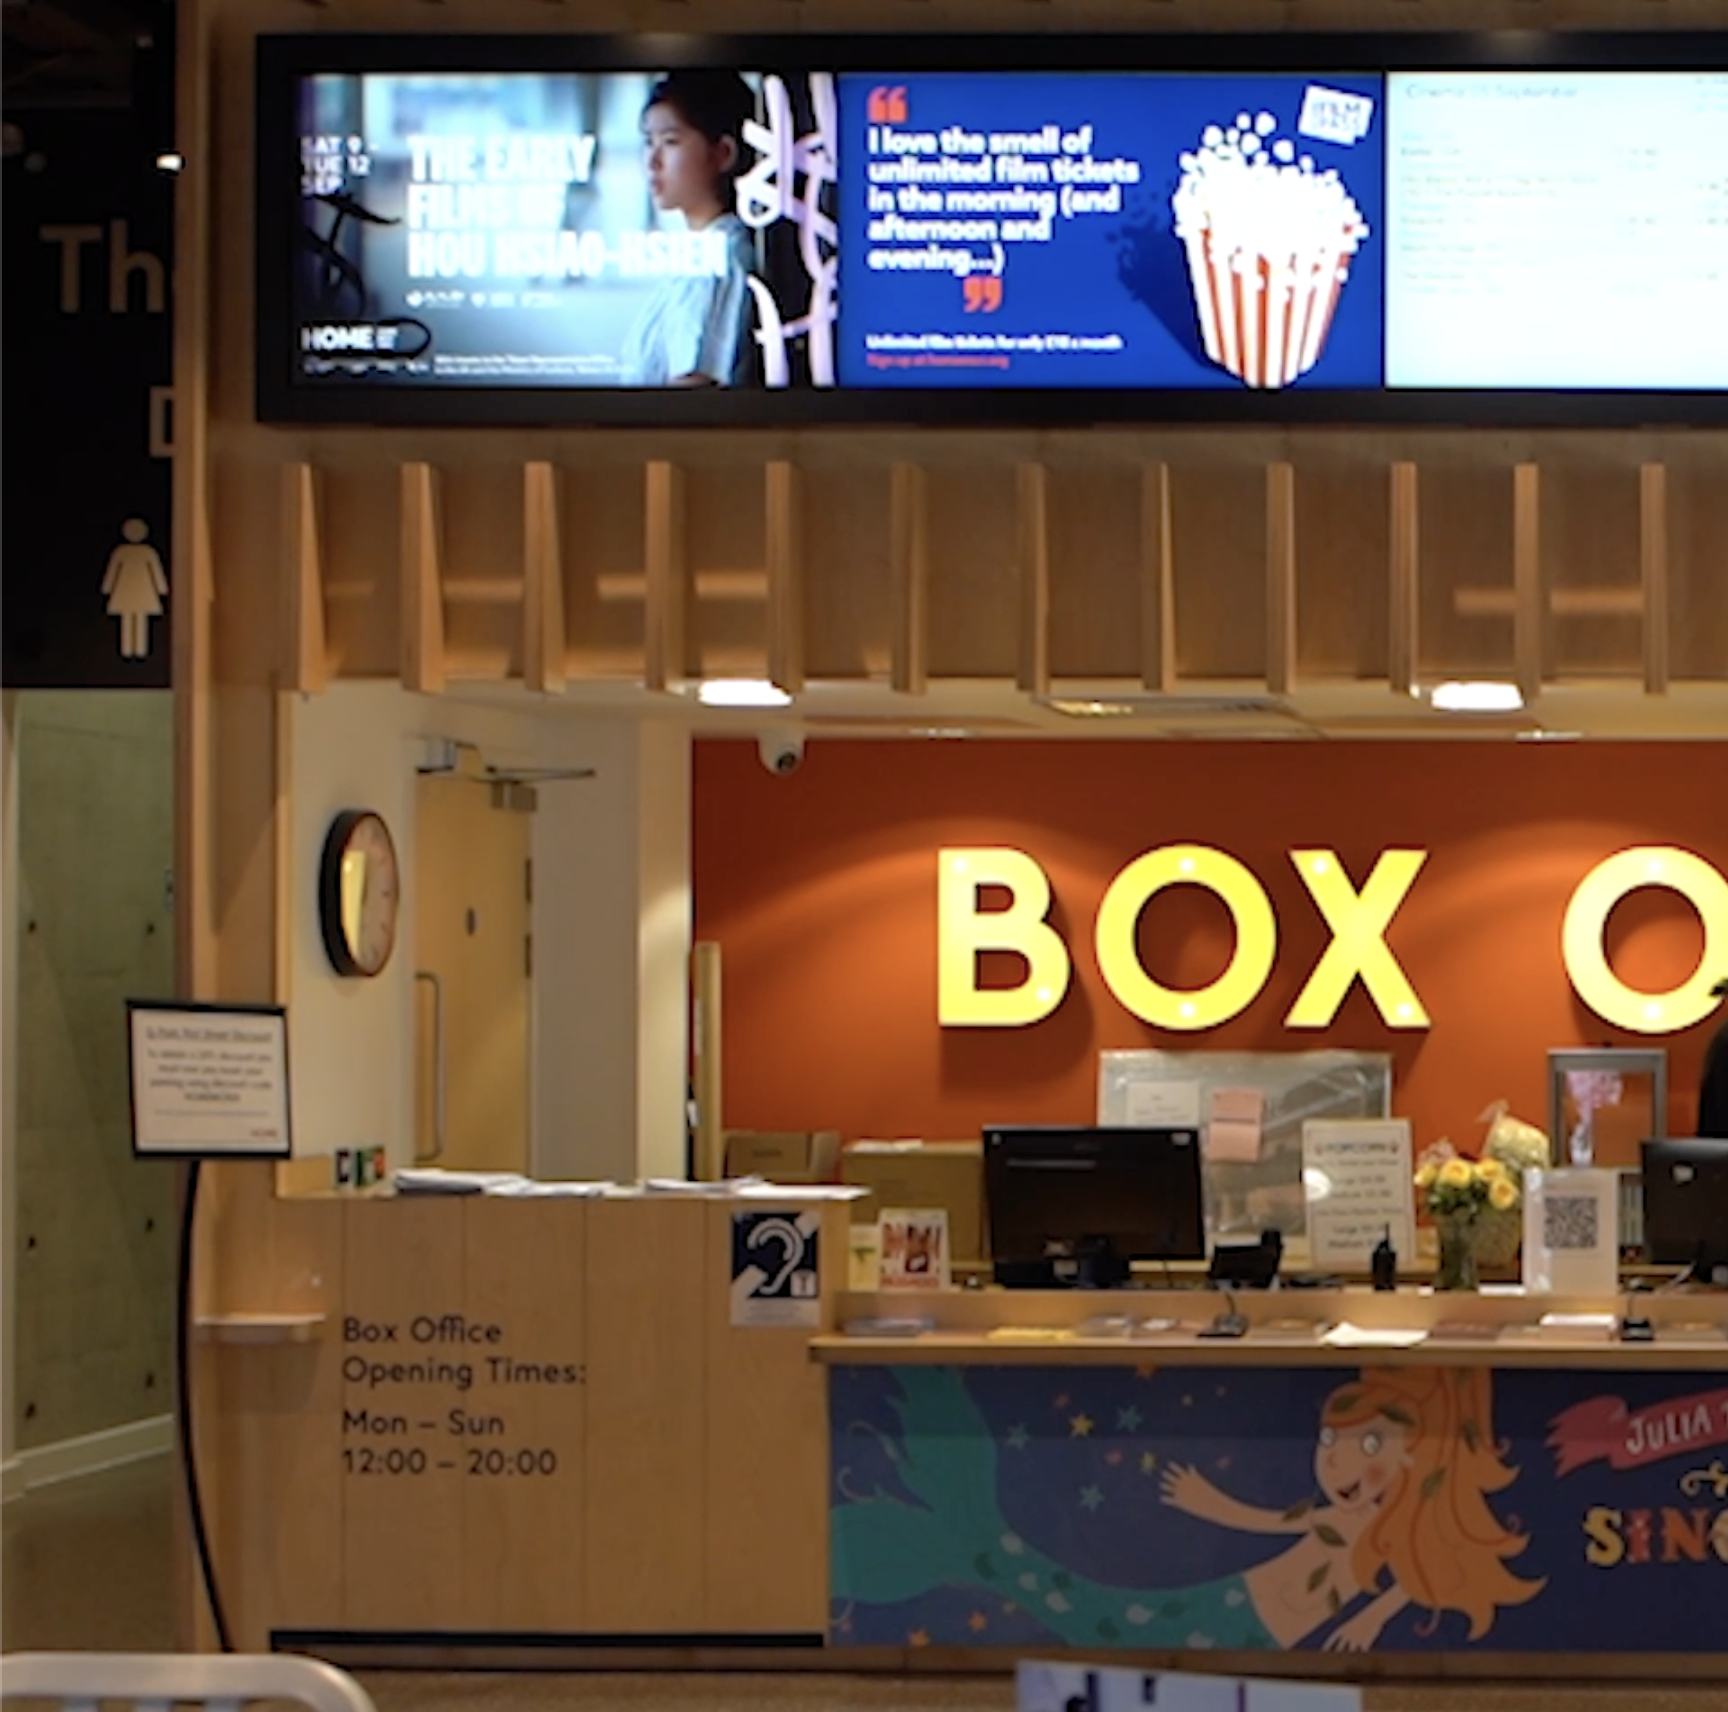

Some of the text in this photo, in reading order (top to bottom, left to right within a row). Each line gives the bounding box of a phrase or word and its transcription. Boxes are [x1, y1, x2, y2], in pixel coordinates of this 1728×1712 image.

[302, 136, 342, 154] SAT
[348, 136, 362, 154] 9
[868, 126, 1093, 154] I love the smell of
[302, 156, 371, 175] TUE 12
[408, 135, 596, 183] THE EARLY
[868, 156, 1140, 184] unlimited film tickets
[302, 177, 342, 195] SEP
[408, 184, 566, 229] FILMS OF
[868, 186, 1121, 218] in the morning (and
[868, 214, 1052, 242] afternoon and
[408, 231, 729, 277] HOU HSIAO-HSIEN
[303, 327, 374, 350] HOME
[938, 844, 1431, 1030] BOX
[343, 1315, 502, 1344] Box Office
[342, 1357, 587, 1392] Opening Times:
[342, 1410, 408, 1436] Mon
[448, 1410, 505, 1436] Sun
[1625, 1405, 1711, 1457] JULIA
[342, 1449, 427, 1475] 12:00
[467, 1449, 558, 1475] 20:00
